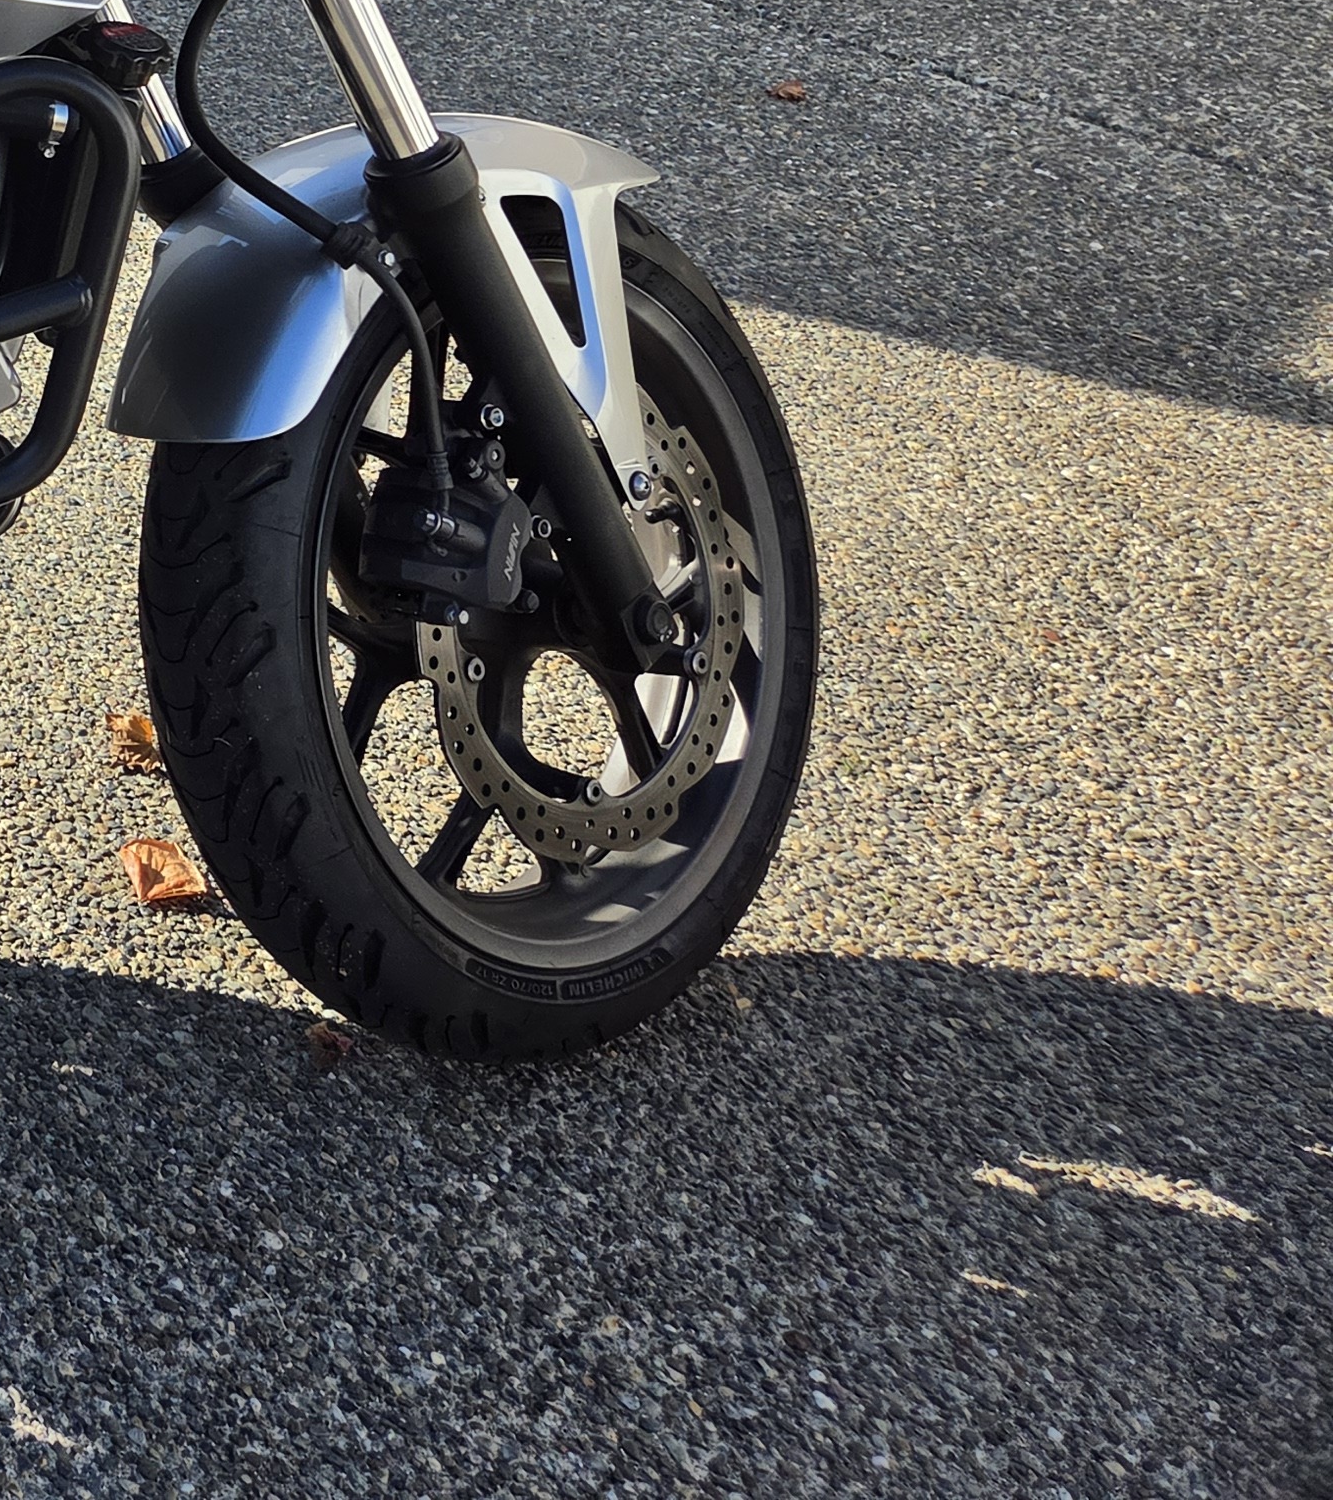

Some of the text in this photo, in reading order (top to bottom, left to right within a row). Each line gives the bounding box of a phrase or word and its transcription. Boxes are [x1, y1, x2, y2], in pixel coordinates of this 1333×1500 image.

[491, 971, 507, 987] ZR
[569, 961, 644, 996] MICHELIN
[511, 979, 553, 996] 120/70
